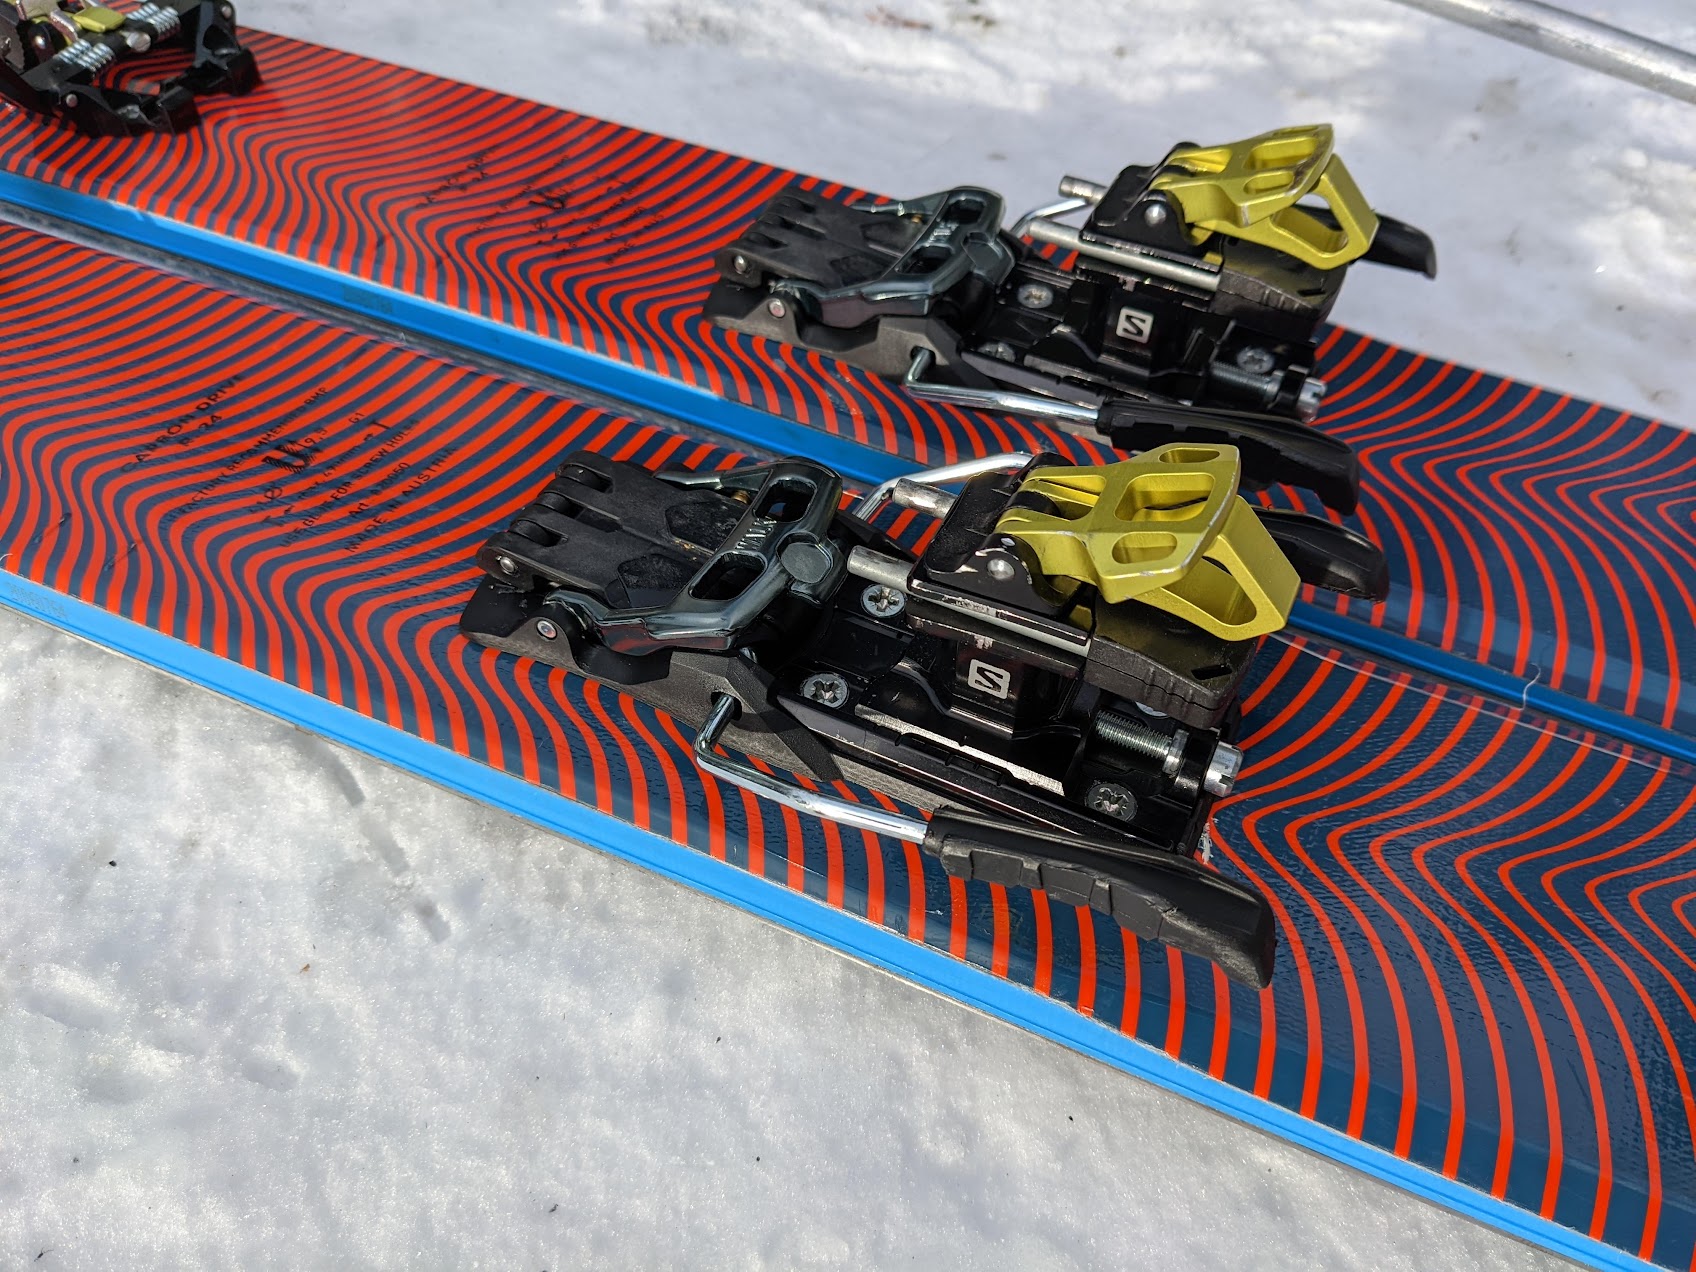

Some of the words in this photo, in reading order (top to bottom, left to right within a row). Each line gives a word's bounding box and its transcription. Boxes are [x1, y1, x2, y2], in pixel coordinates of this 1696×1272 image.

[328, 479, 354, 500] FOR
[349, 447, 390, 480] SCREW
[342, 514, 389, 553] MADE
